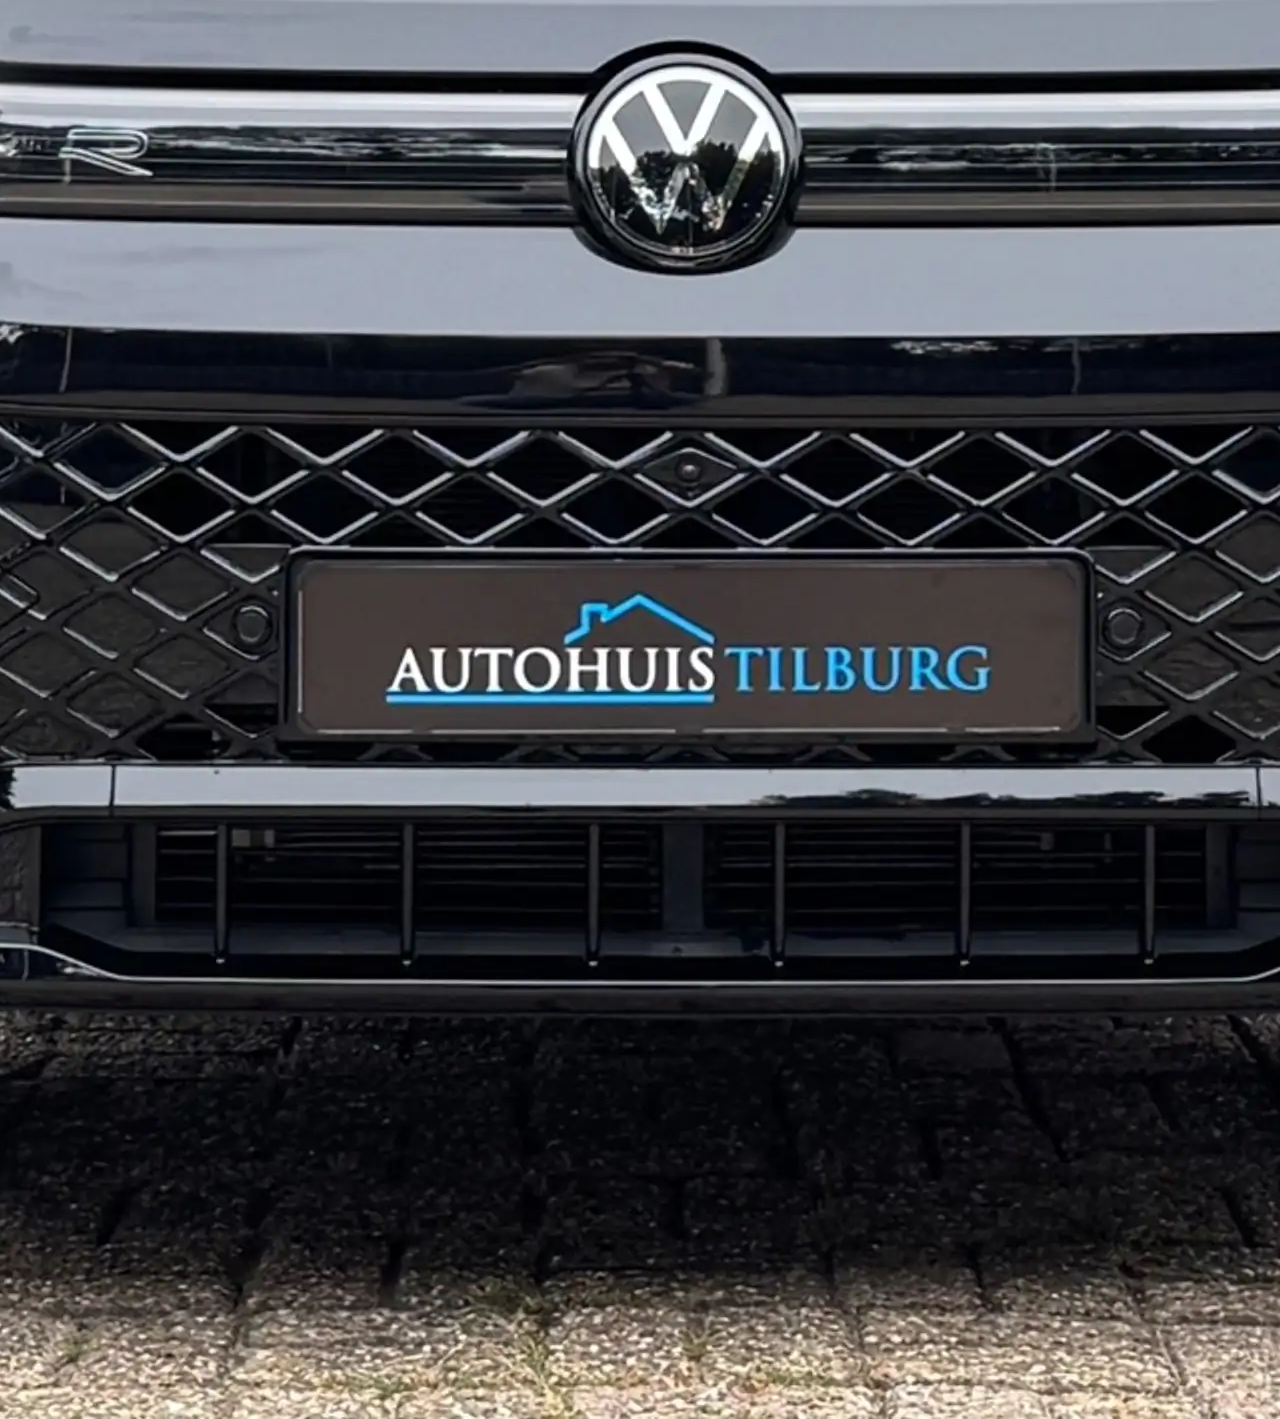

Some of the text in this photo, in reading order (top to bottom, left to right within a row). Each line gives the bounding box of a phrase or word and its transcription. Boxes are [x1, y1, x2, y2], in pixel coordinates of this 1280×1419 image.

[58, 127, 154, 177] R
[385, 644, 991, 693] AUTOHUIS TILBURG
